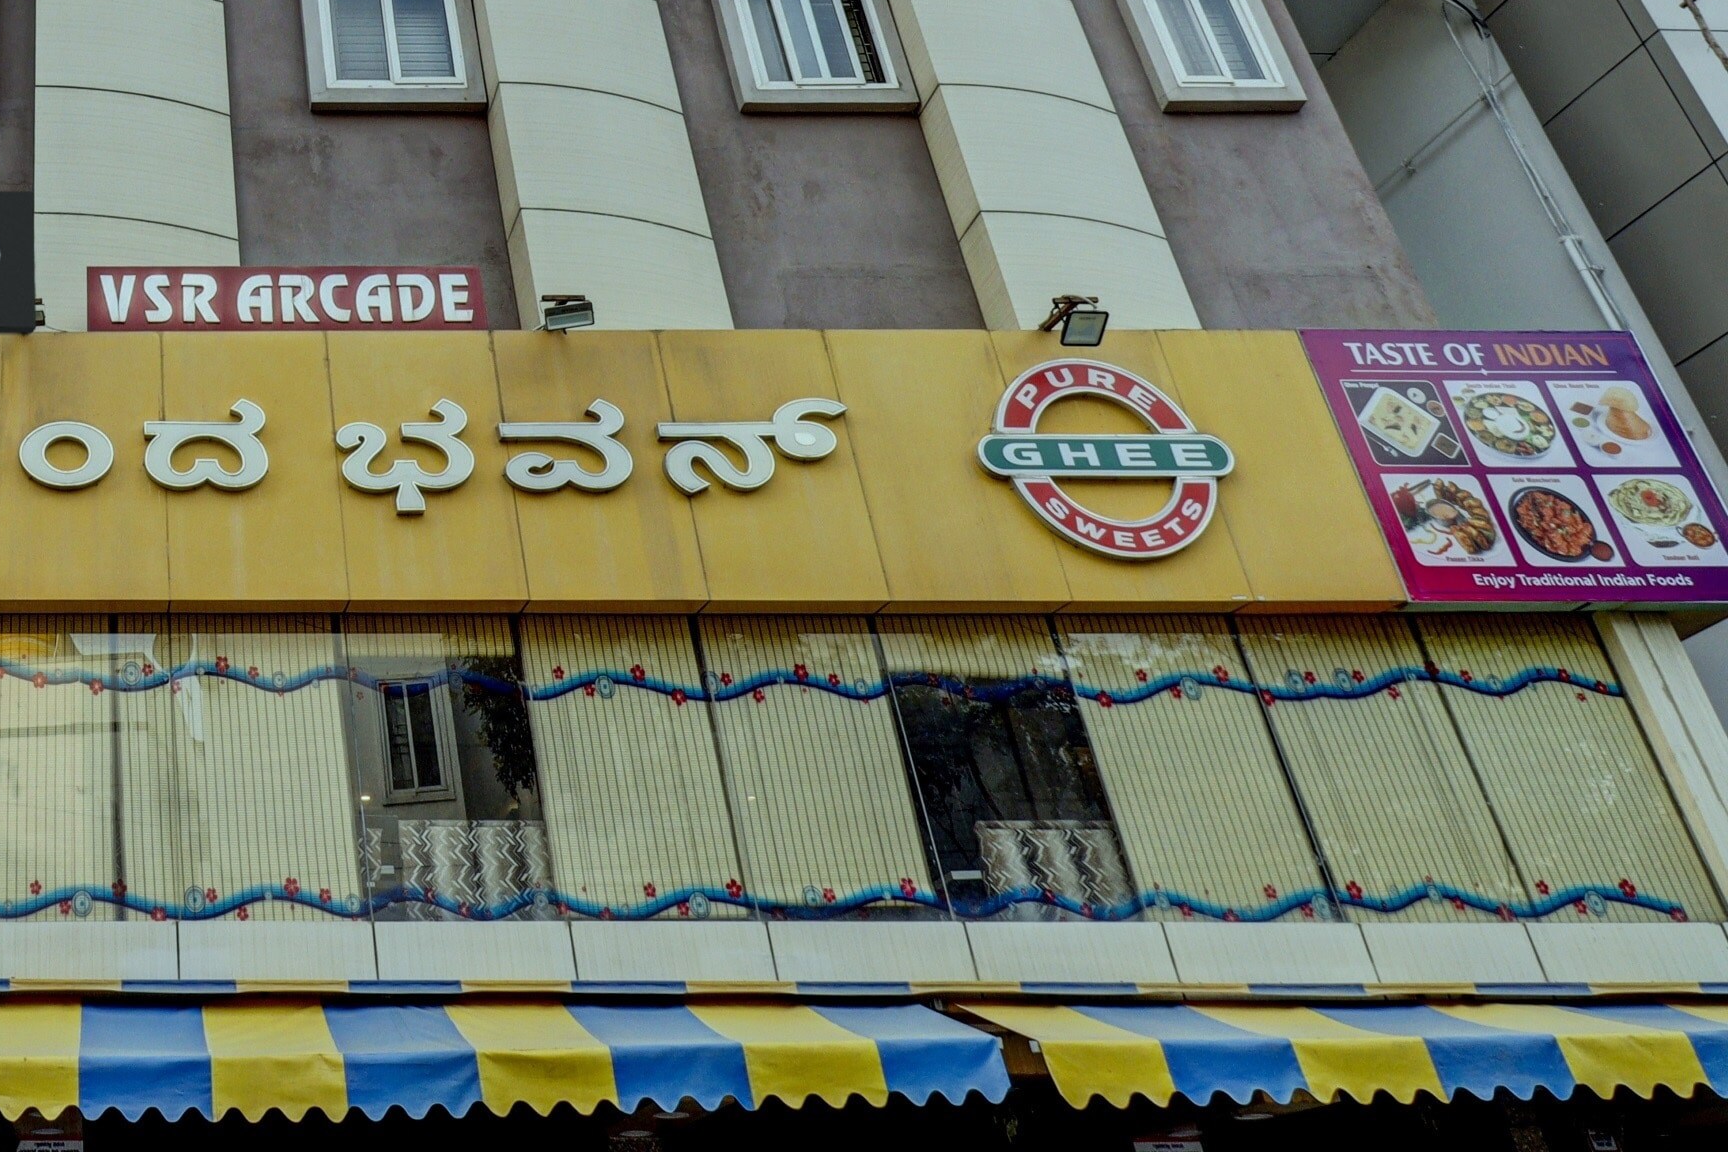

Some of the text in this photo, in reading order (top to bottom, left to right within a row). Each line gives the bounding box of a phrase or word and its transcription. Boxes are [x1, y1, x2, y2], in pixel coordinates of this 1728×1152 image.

[99, 274, 475, 324] VSR ARCADE
[1342, 342, 1610, 366] TASTE OF INDIAN
[1015, 368, 1156, 411] PURE
[1002, 442, 1213, 467] GHEE
[1045, 498, 1202, 548] SWEETS
[1472, 573, 1694, 588] Enjoy Traditional Indian Foods
